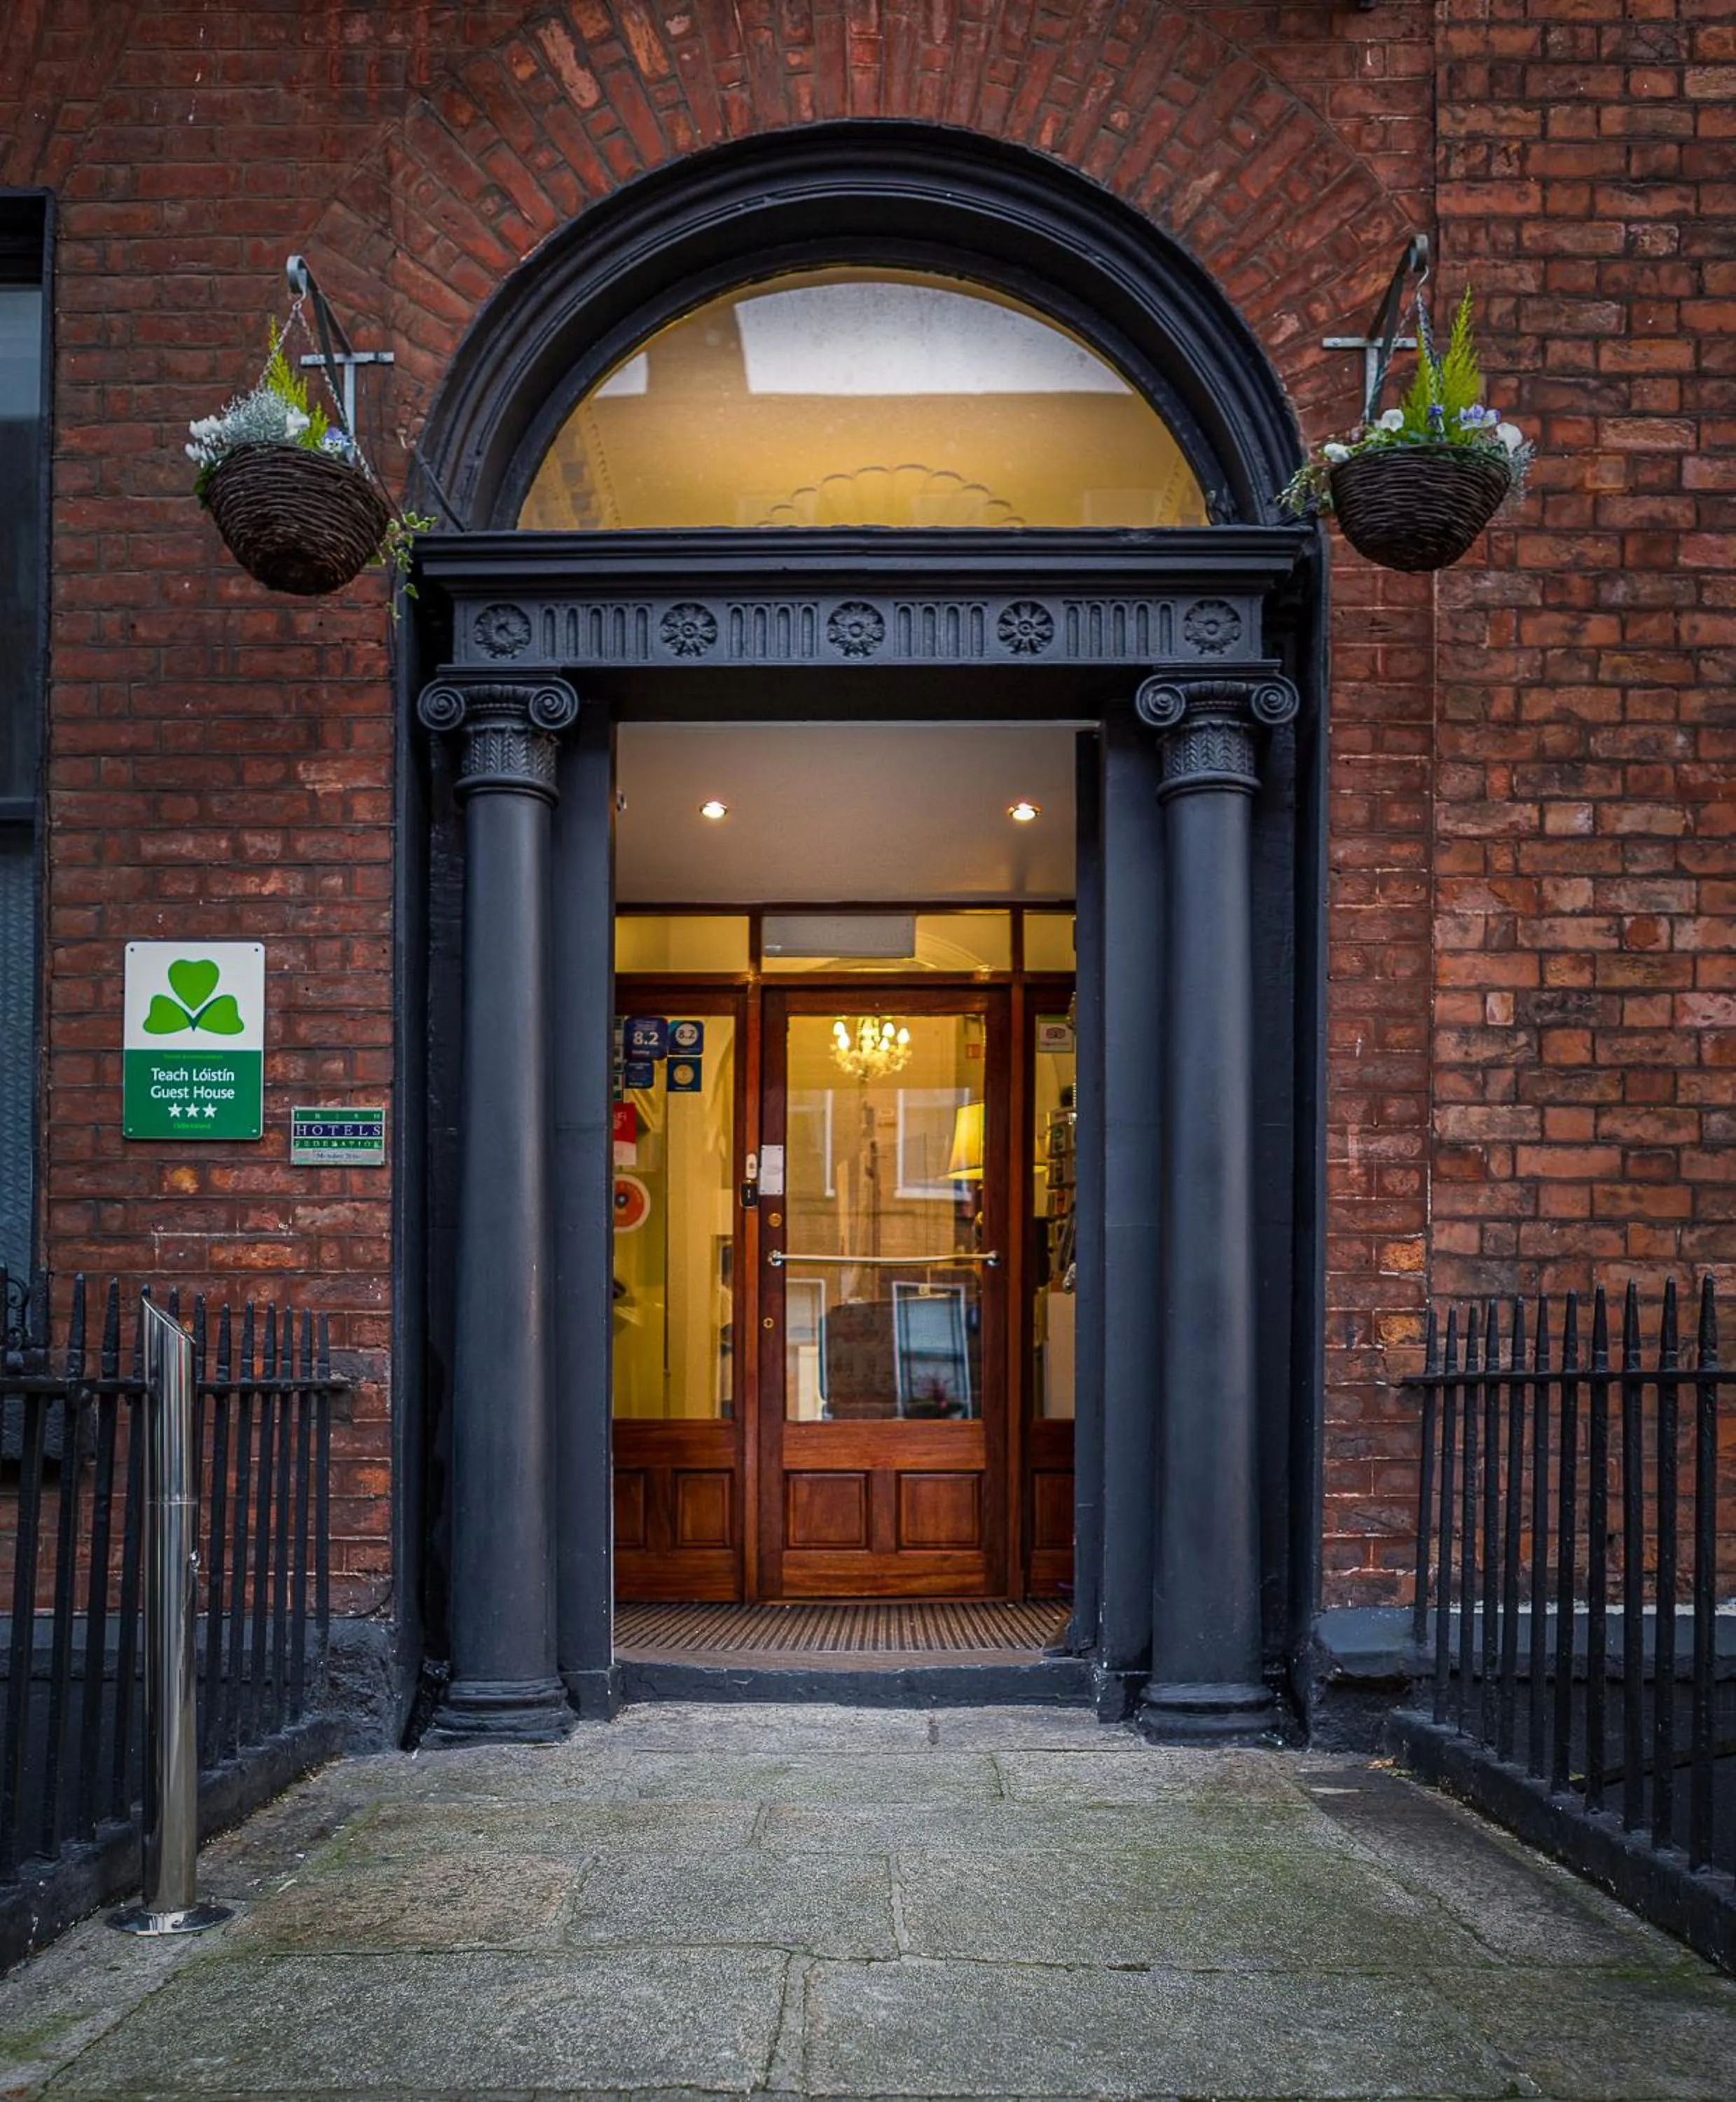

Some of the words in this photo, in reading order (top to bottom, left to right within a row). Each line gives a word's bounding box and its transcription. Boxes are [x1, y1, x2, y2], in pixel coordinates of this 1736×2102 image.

[633, 1031, 659, 1045] 8.2
[678, 1029, 696, 1039] 8.2
[151, 1067, 188, 1081] Teach
[193, 1067, 235, 1081] Lóistín
[151, 1085, 190, 1099] Guest
[193, 1085, 235, 1099] House
[296, 1125, 381, 1136] HOTELS
